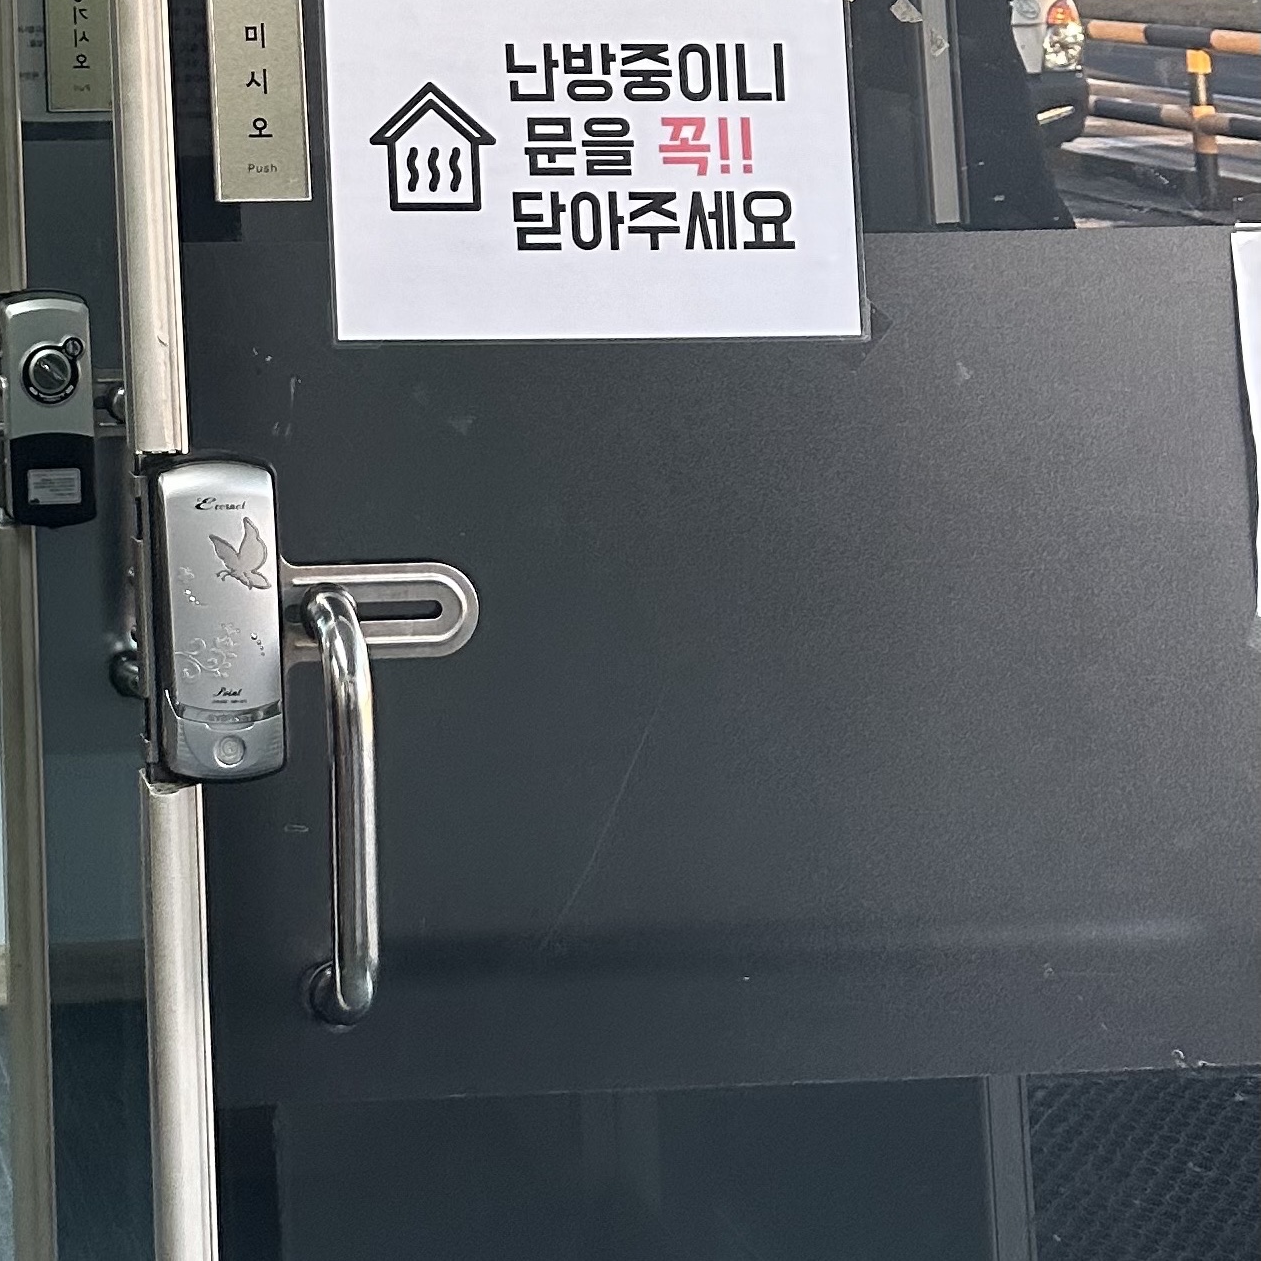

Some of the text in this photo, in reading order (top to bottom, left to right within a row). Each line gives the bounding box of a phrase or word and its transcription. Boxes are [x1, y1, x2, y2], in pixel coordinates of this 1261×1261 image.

[244, 23, 273, 138] 미시오
[504, 43, 786, 102] 난방중이니
[247, 163, 278, 174] Push
[524, 117, 753, 176] 문을 꼭!!
[512, 191, 796, 251] 닫아주세요
